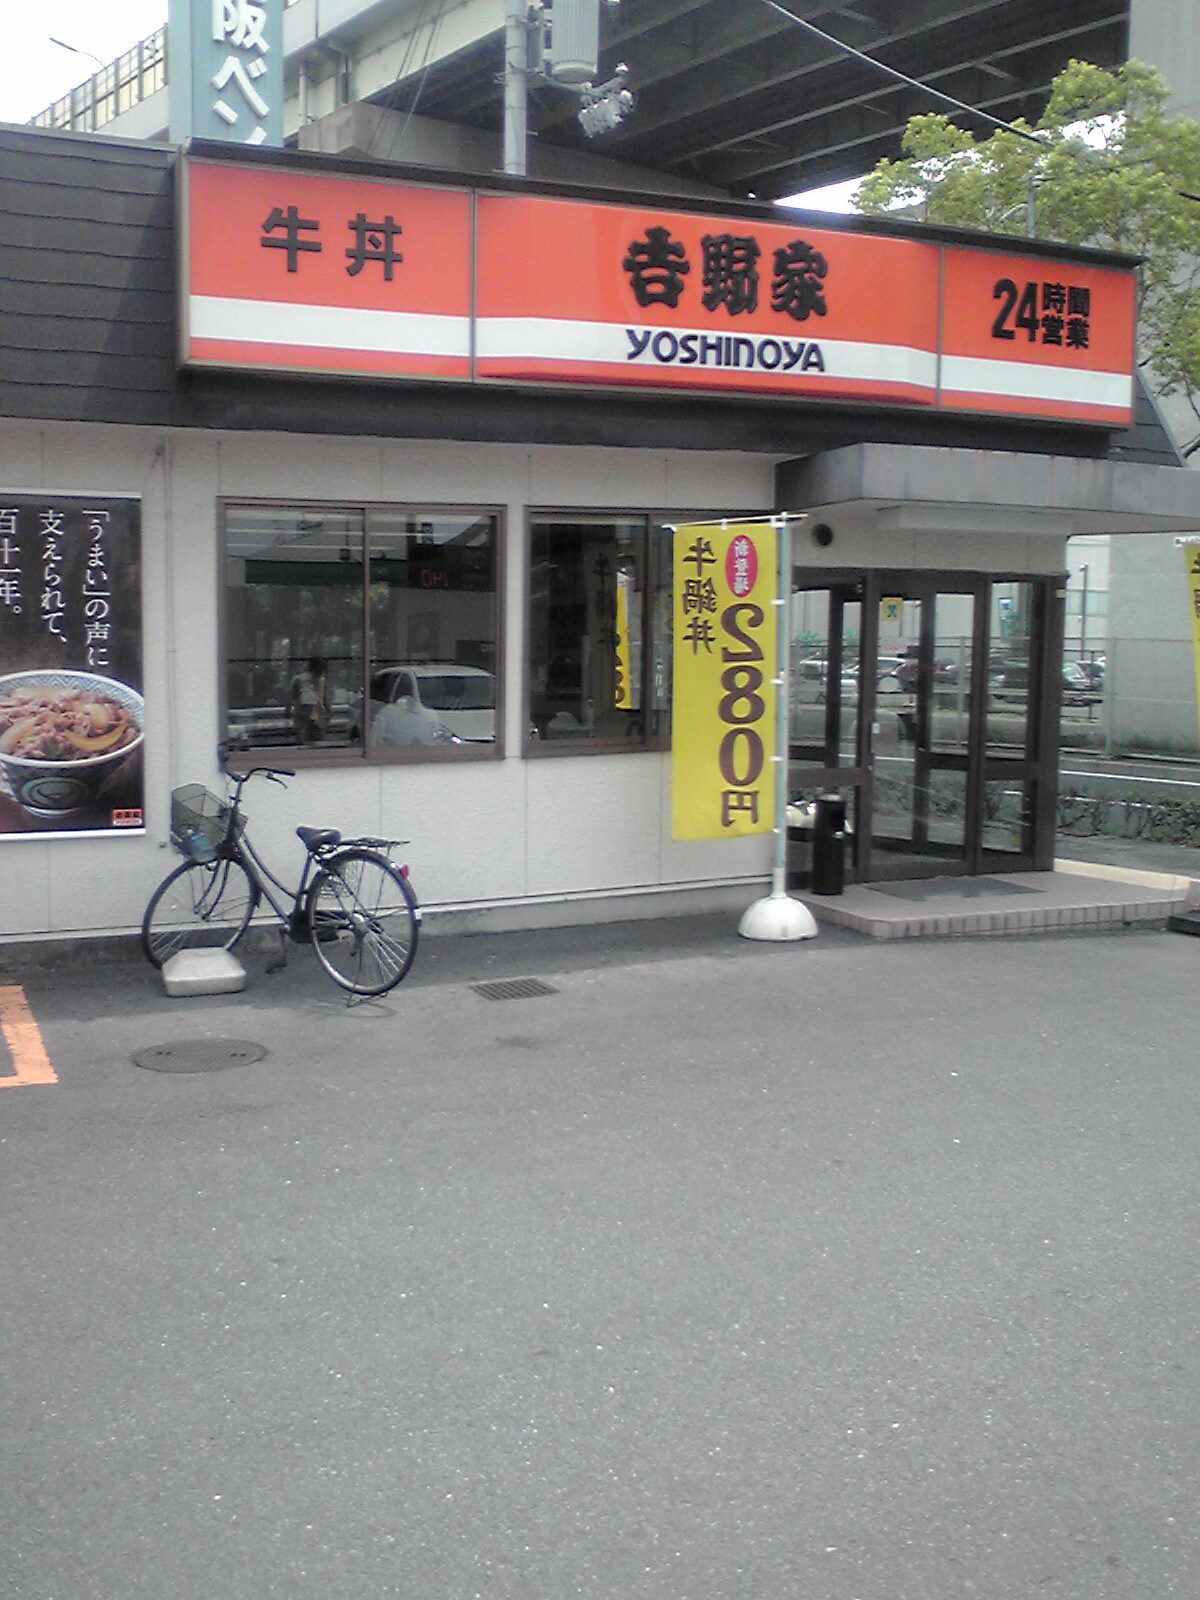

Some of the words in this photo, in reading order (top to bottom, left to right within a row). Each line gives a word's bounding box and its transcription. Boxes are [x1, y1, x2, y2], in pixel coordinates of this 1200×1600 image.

[261, 205, 403, 281] 牛丼
[623, 226, 828, 321] 吉野家
[38, 509, 68, 644] 支えられて、
[82, 509, 112, 666] 「うまい」の声に
